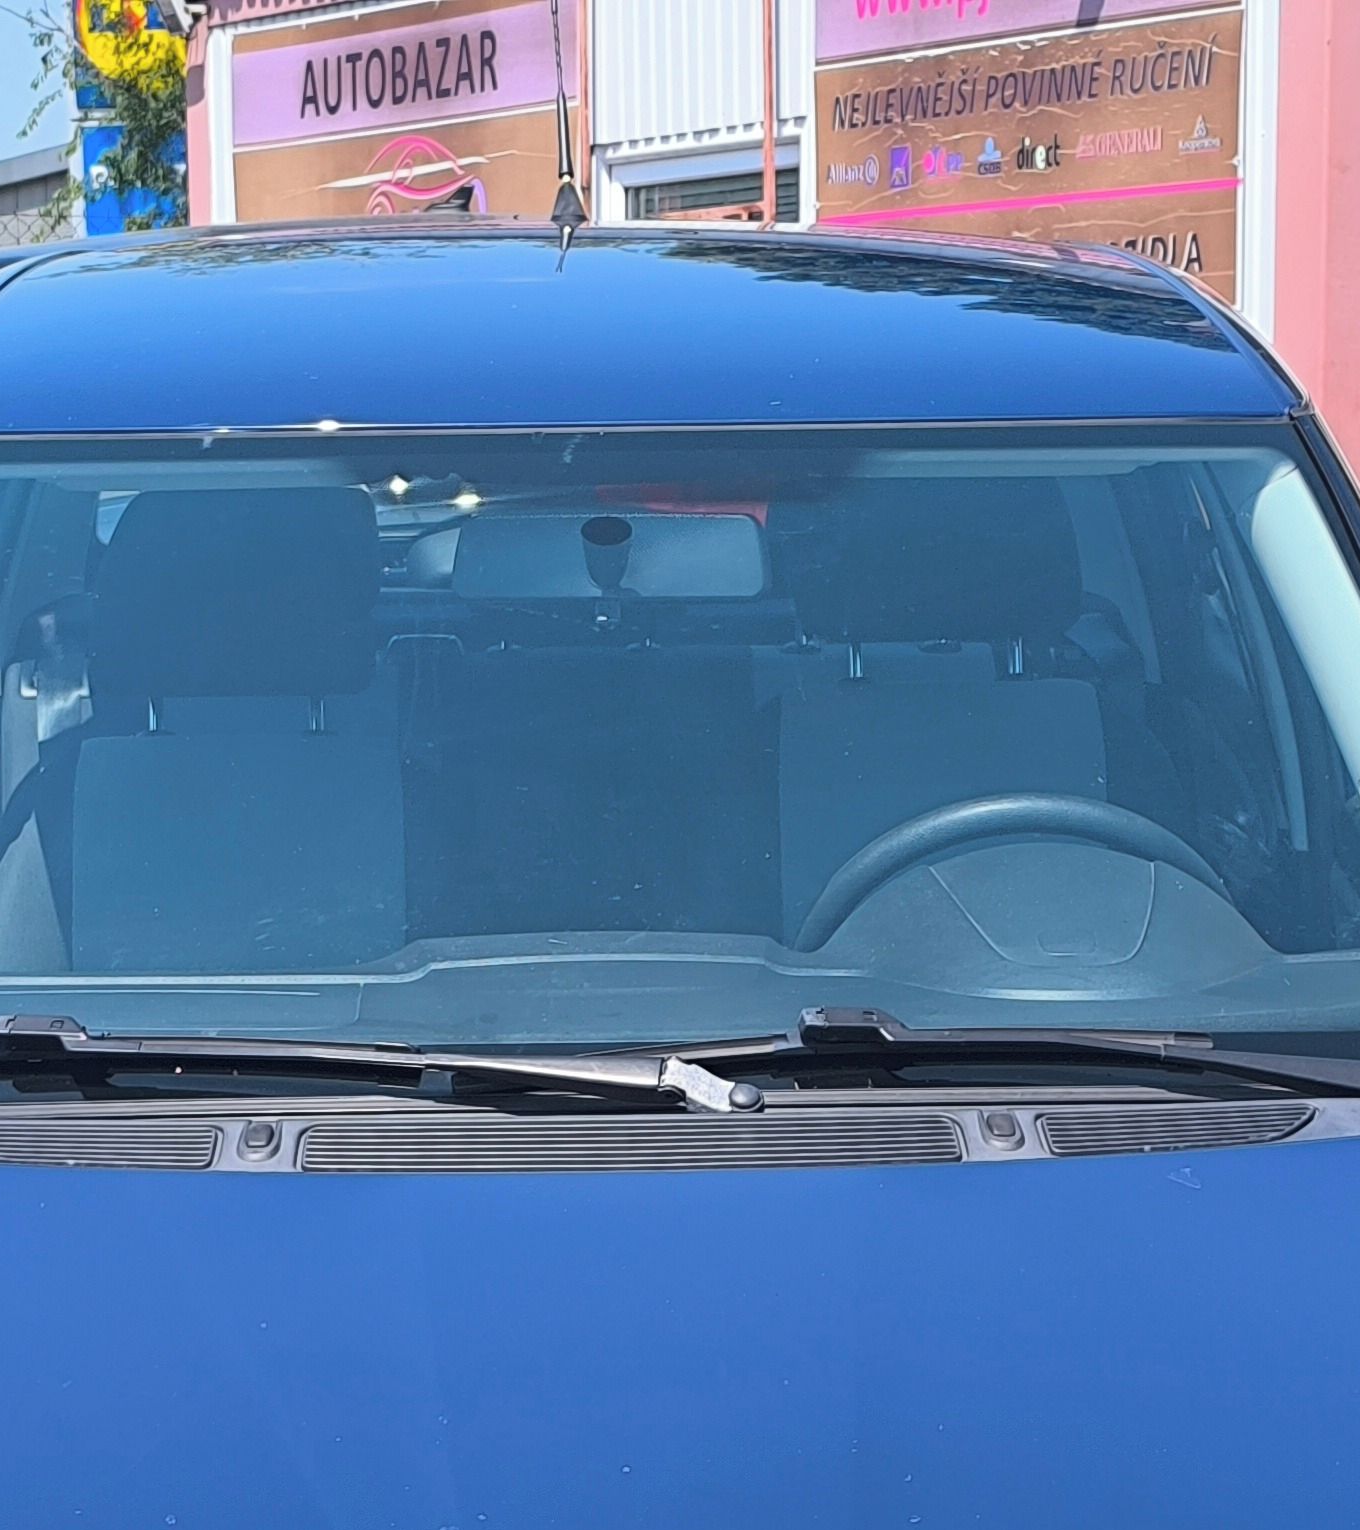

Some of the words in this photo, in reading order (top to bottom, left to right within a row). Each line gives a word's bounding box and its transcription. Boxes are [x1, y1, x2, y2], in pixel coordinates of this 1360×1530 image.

[300, 29, 499, 119] AUTOBAZAR
[832, 65, 981, 131] NEJLEVNĚJŠÍ
[984, 49, 1102, 111] POVINNÉ
[1110, 32, 1218, 97] RUČENÍ
[1017, 133, 1061, 170] direct
[1095, 126, 1163, 157] GENERALI
